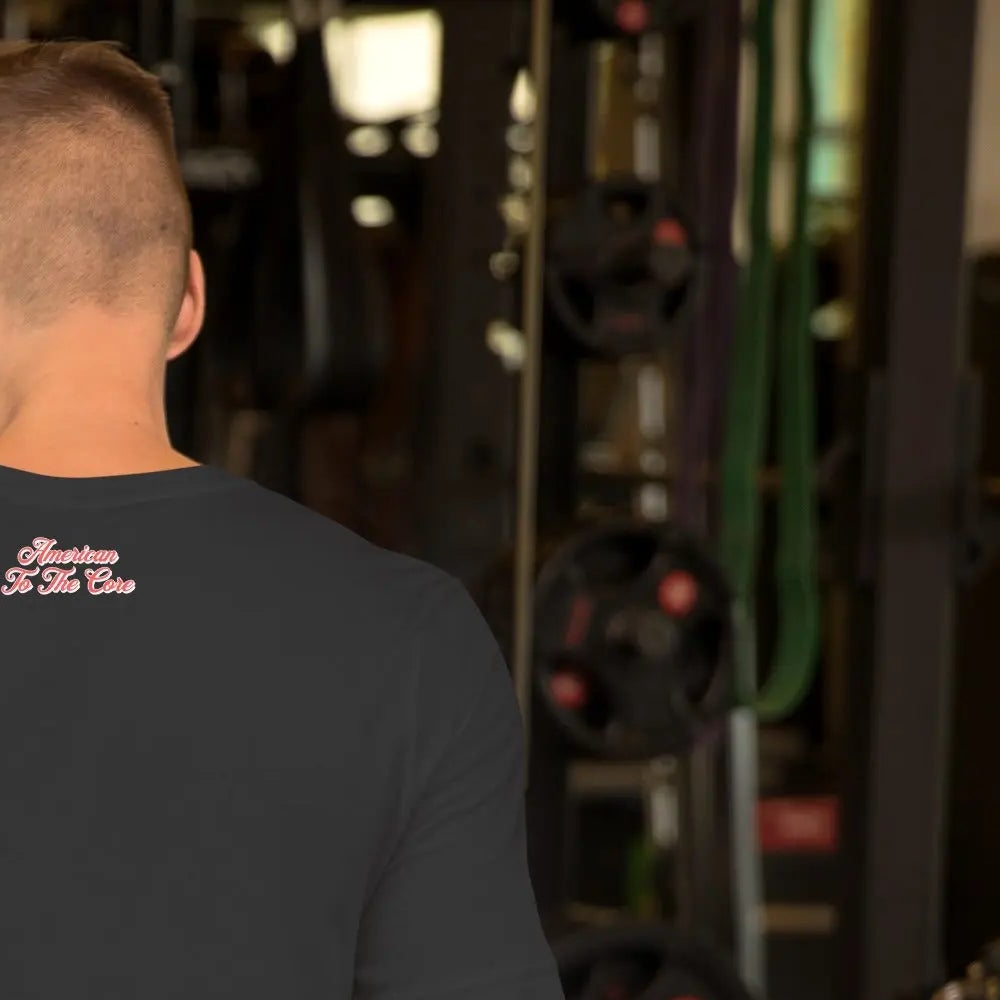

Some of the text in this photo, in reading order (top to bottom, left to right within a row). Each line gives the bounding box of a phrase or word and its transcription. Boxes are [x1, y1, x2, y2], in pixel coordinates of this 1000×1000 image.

[17, 537, 119, 566] American
[1, 566, 136, 595] To The Core
